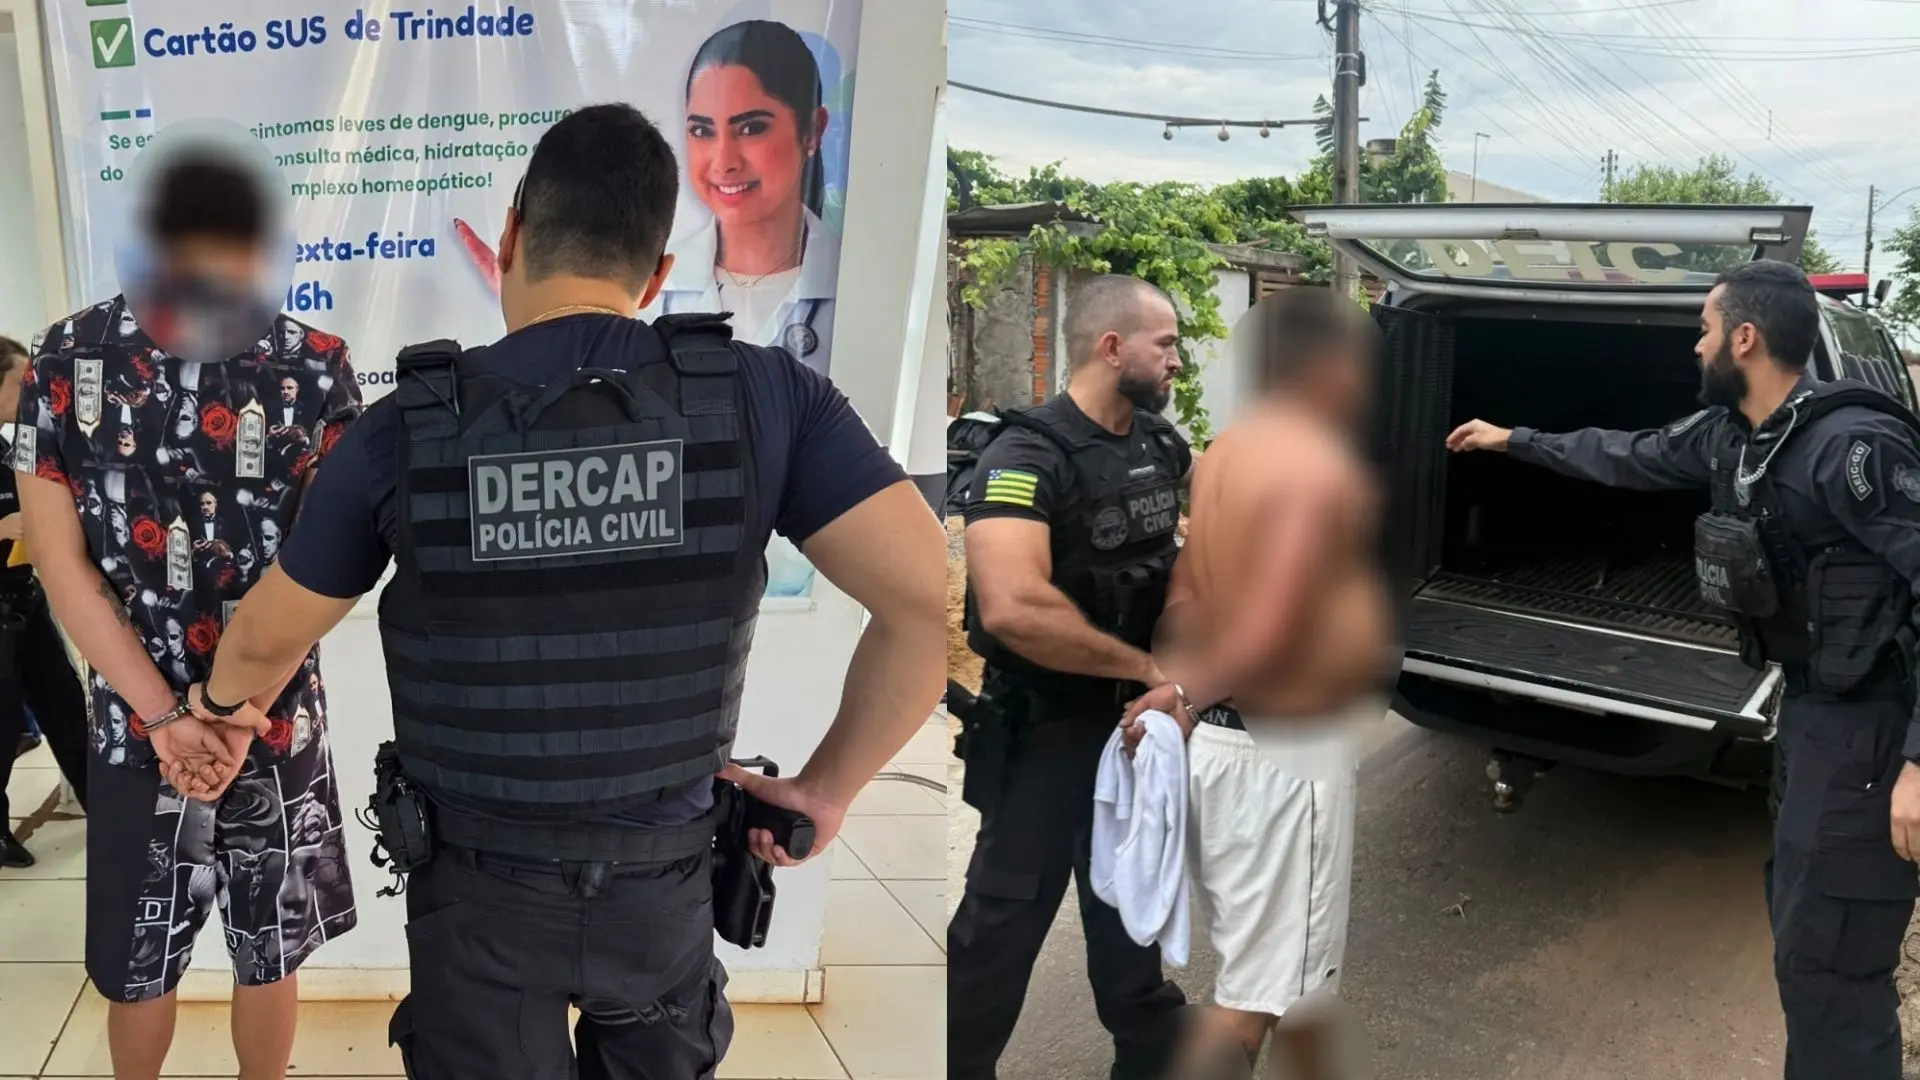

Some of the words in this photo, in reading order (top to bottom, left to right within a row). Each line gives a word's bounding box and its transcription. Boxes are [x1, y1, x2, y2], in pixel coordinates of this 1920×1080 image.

[143, 22, 257, 57] Cartão
[266, 16, 327, 50] SUS
[344, 9, 381, 41] de
[389, 5, 534, 41] Trindade
[108, 134, 132, 150] Se
[339, 115, 385, 132] leves
[389, 114, 413, 130] de
[417, 111, 494, 131] dengue,
[100, 166, 123, 182] do
[274, 147, 341, 167] onsulta
[345, 144, 420, 165] médica,
[424, 140, 528, 162] hidratação
[291, 179, 358, 200] mplexo
[362, 171, 493, 196] homeopático!
[296, 231, 436, 263] exta-feira
[476, 450, 675, 515] DERCAP
[480, 514, 592, 552] POLÍCIA
[600, 508, 675, 543] CIVIL
